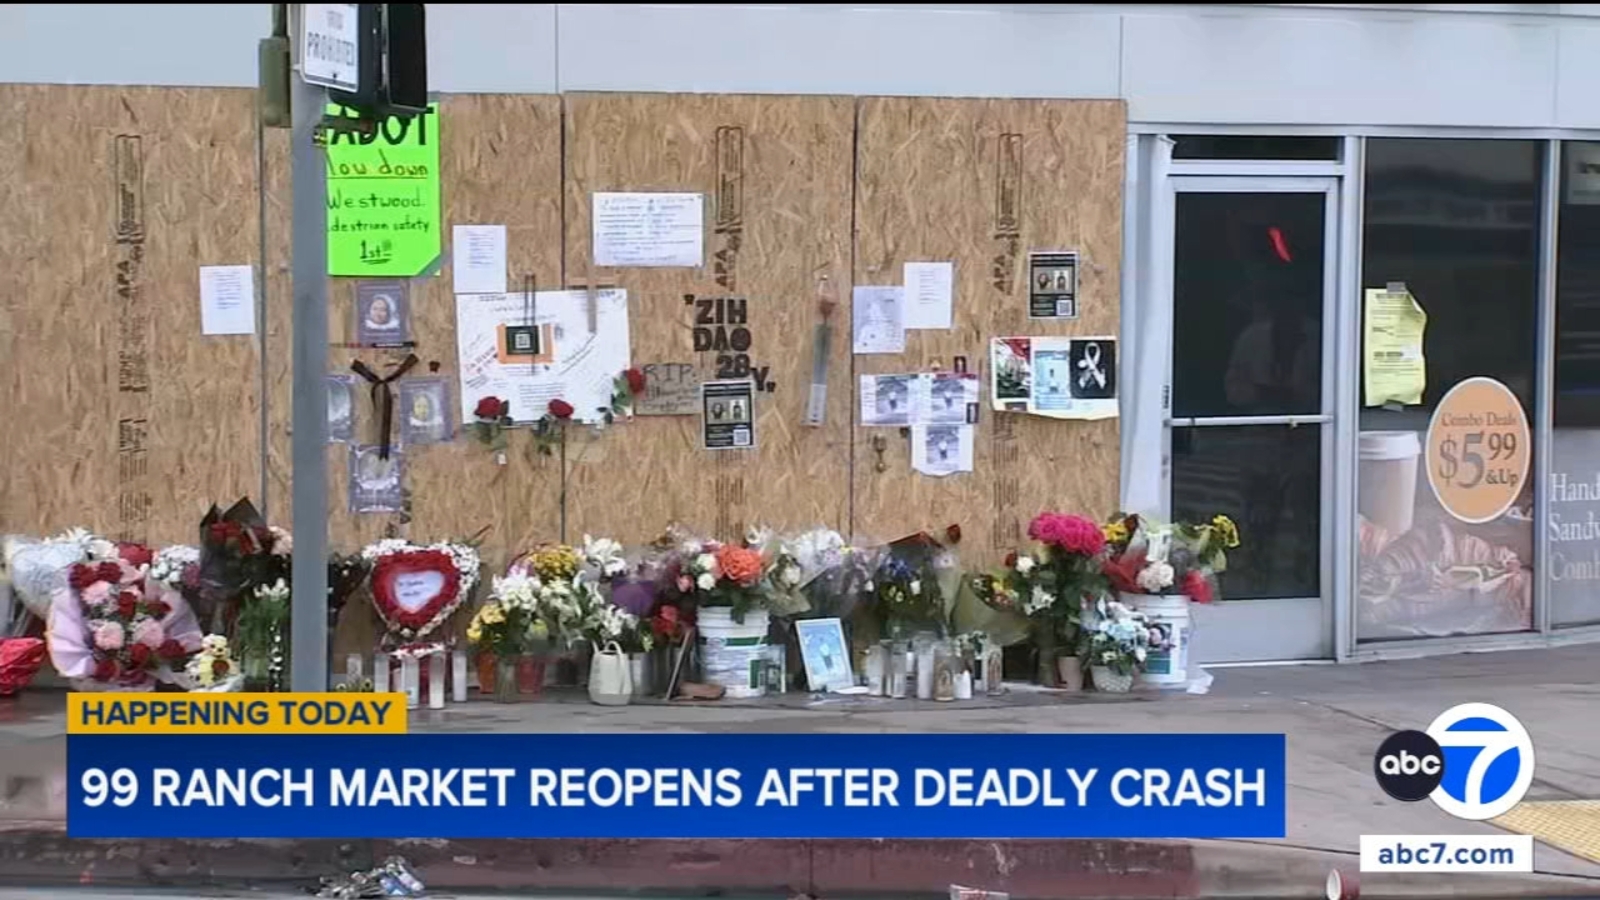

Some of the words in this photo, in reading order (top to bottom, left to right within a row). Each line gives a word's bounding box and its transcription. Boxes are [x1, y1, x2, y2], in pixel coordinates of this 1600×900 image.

[326, 151, 367, 176] low
[378, 148, 428, 176] down
[693, 327, 751, 352] DAO
[715, 354, 751, 379] 28
[1441, 412, 1484, 427] Combo
[1485, 411, 1517, 427] Deals
